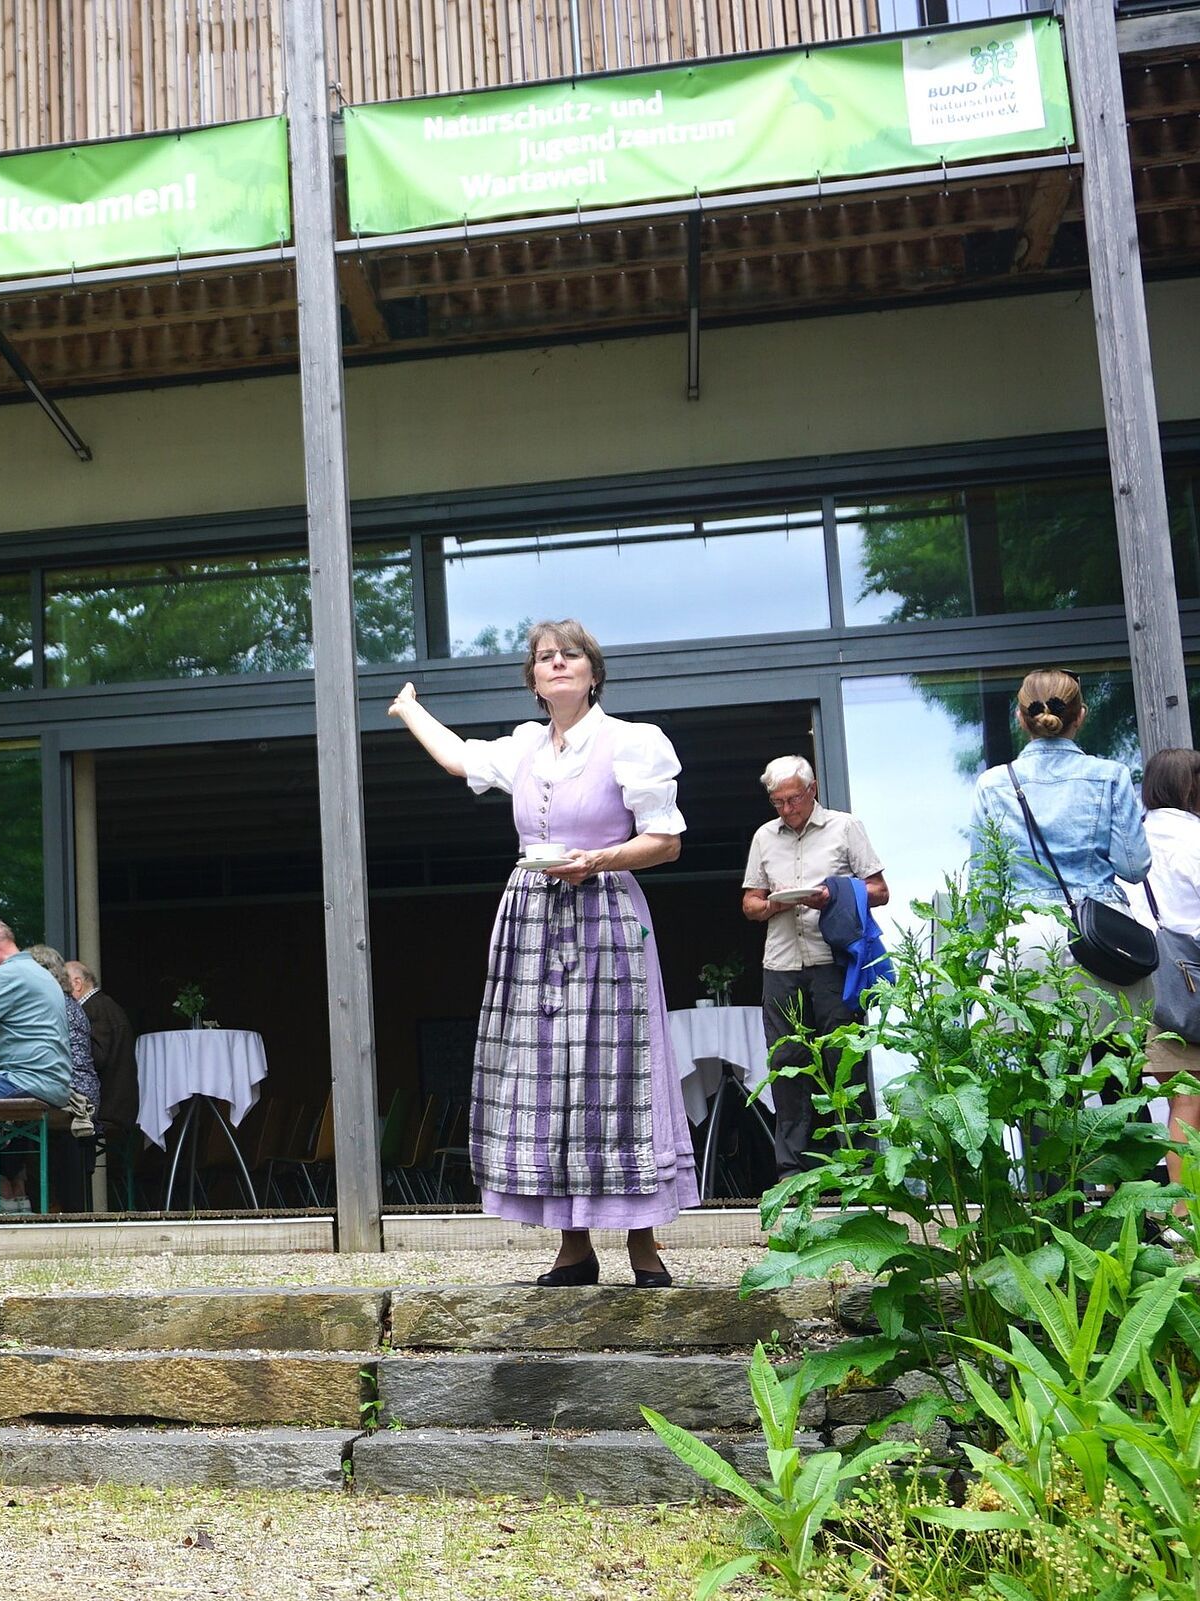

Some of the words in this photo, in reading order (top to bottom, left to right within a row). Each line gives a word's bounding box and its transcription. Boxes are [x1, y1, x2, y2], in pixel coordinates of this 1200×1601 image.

[928, 82, 977, 98] BUND
[929, 91, 1016, 112] Naturschutz
[424, 102, 599, 140] Naturschutz-
[611, 90, 663, 117] und
[947, 109, 994, 123] Bayern
[998, 103, 1019, 115] e.V.
[460, 159, 607, 199] Wartaweil
